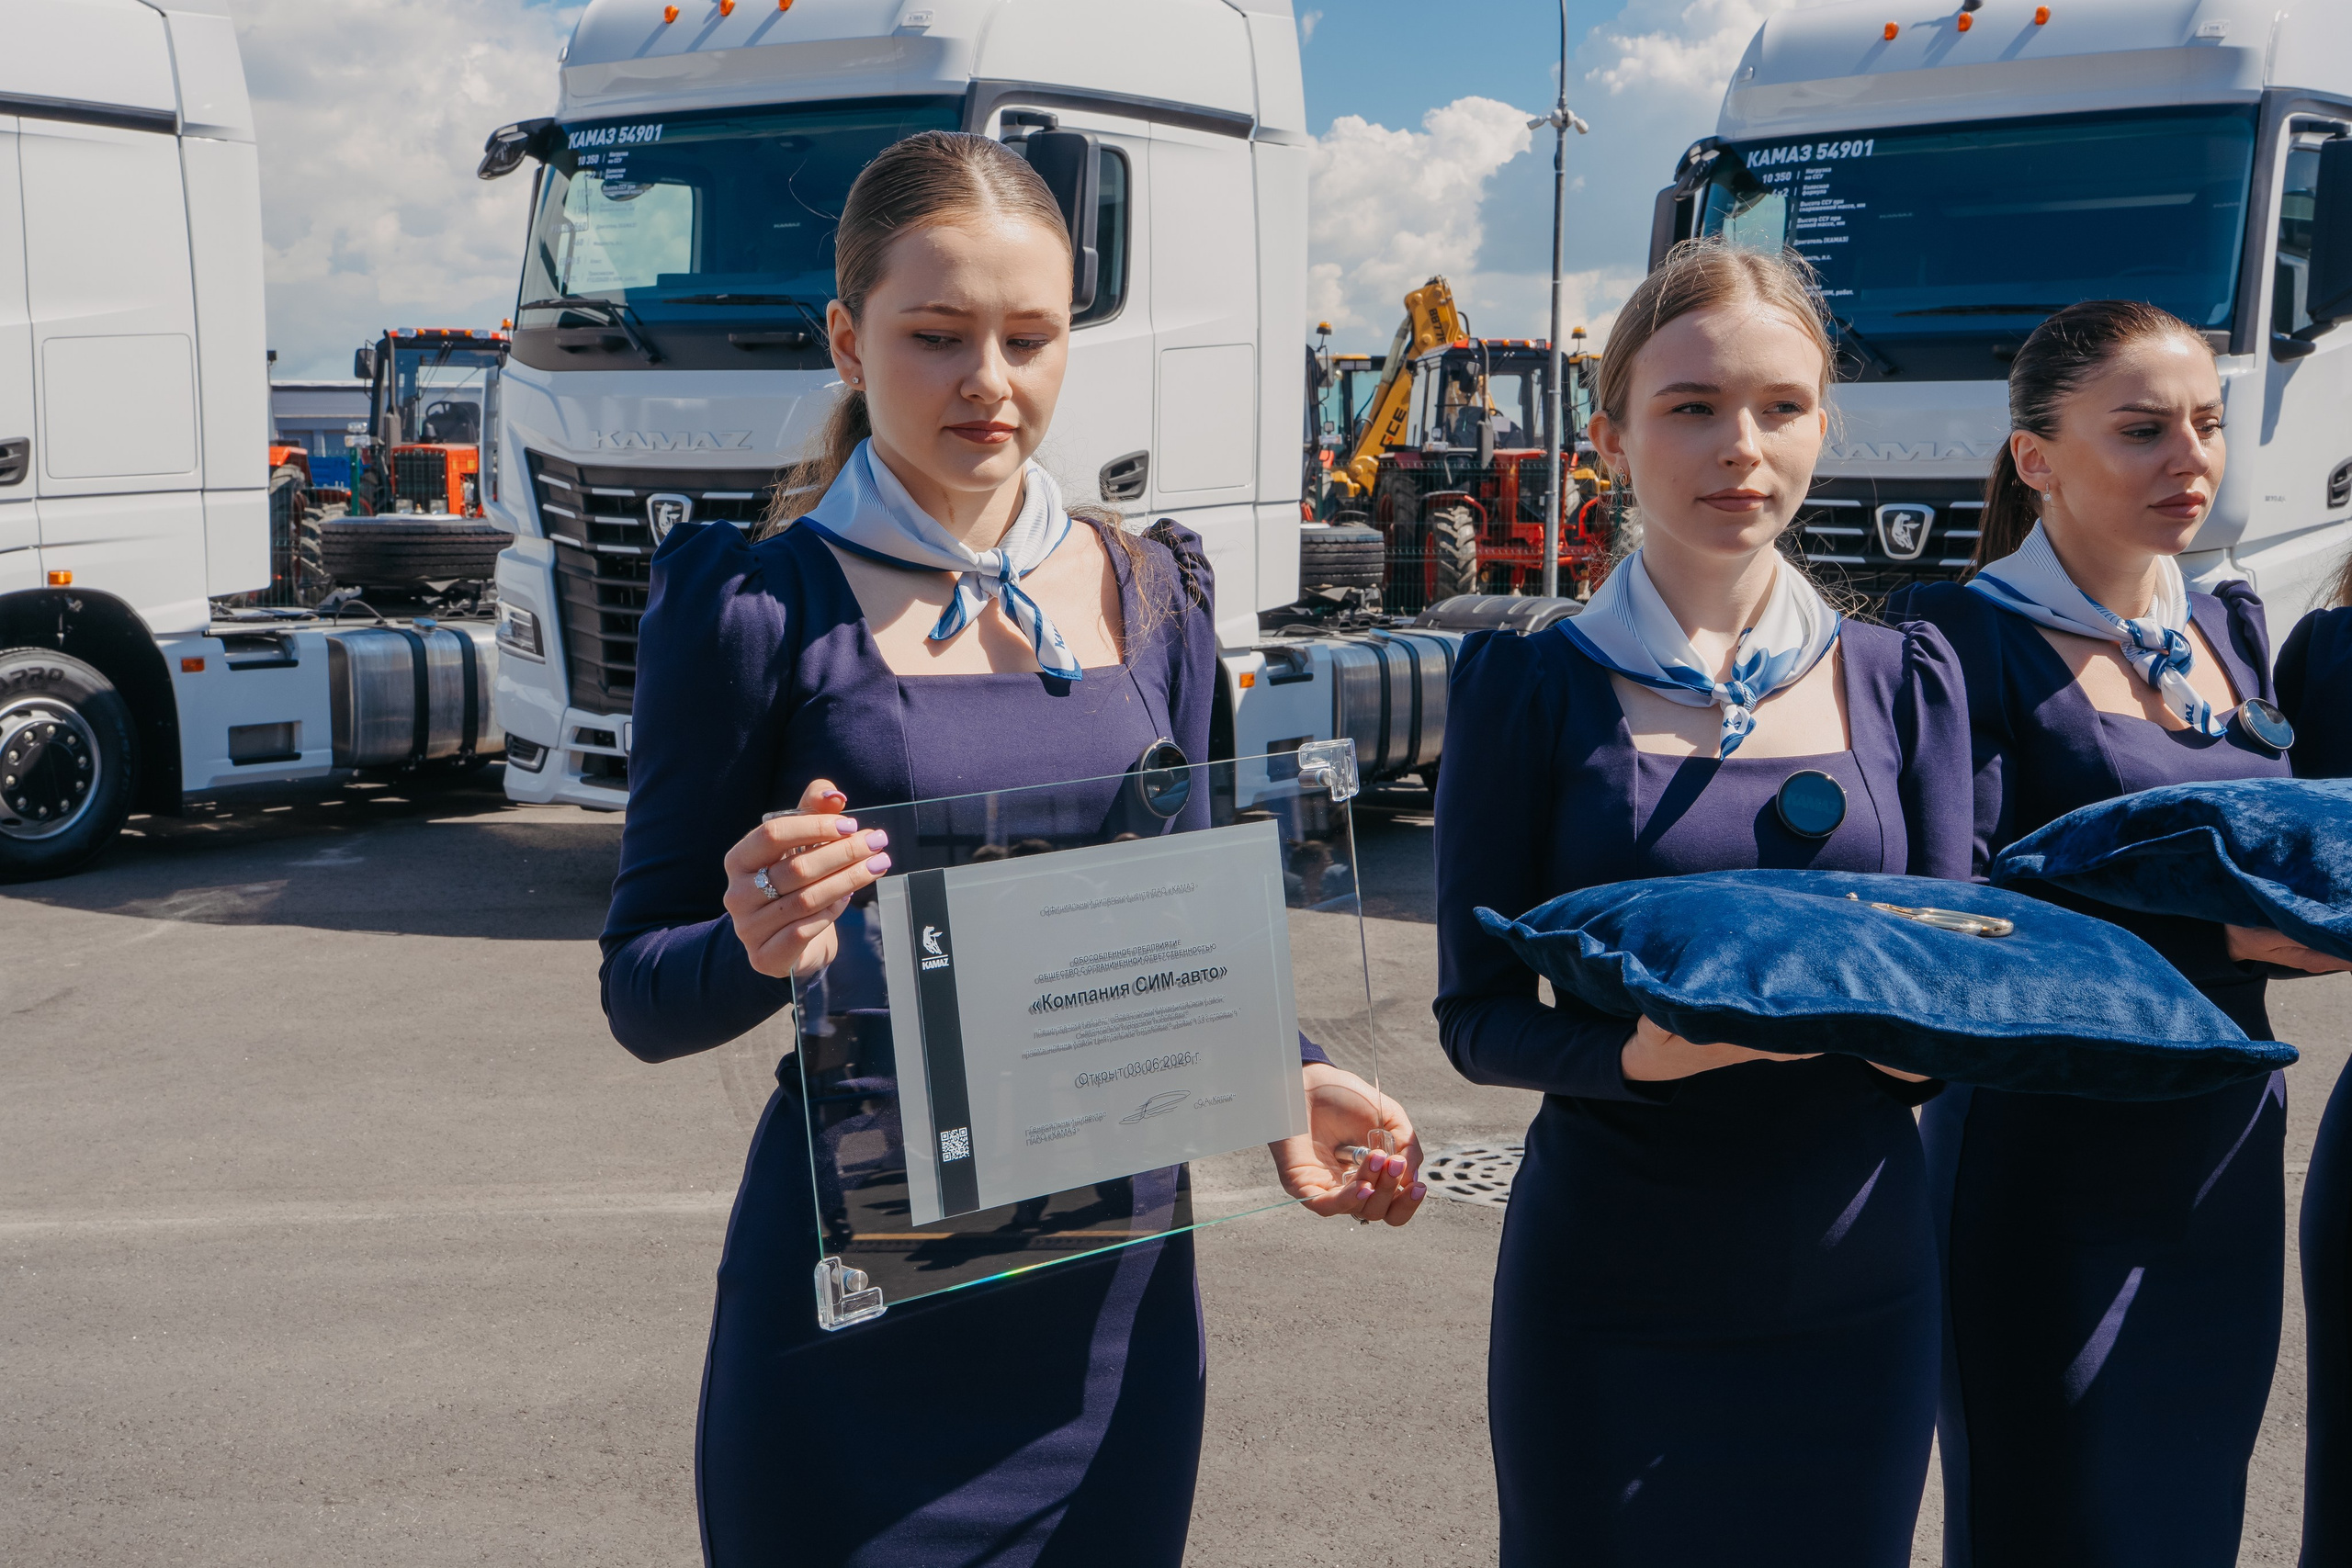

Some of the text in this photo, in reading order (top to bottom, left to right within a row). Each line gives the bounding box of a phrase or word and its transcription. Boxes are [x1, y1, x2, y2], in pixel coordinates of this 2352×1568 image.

[568, 124, 662, 150] КАМАЗ 54901
[1747, 139, 1874, 168] КАМАЗ 54901
[1762, 171, 1792, 184] 10 350
[593, 430, 752, 451] KAMAZ
[1071, 939, 1182, 965] ОБОСОБЛЕННОЕ ПРЕДПРИЯТИЕ
[922, 958, 949, 970] KAMAZ
[1036, 967, 1080, 983] ОБЩЕСТВО
[1031, 965, 1228, 1012] «Компания СИМ-авто»
[1076, 1066, 1124, 1088] Открыт
